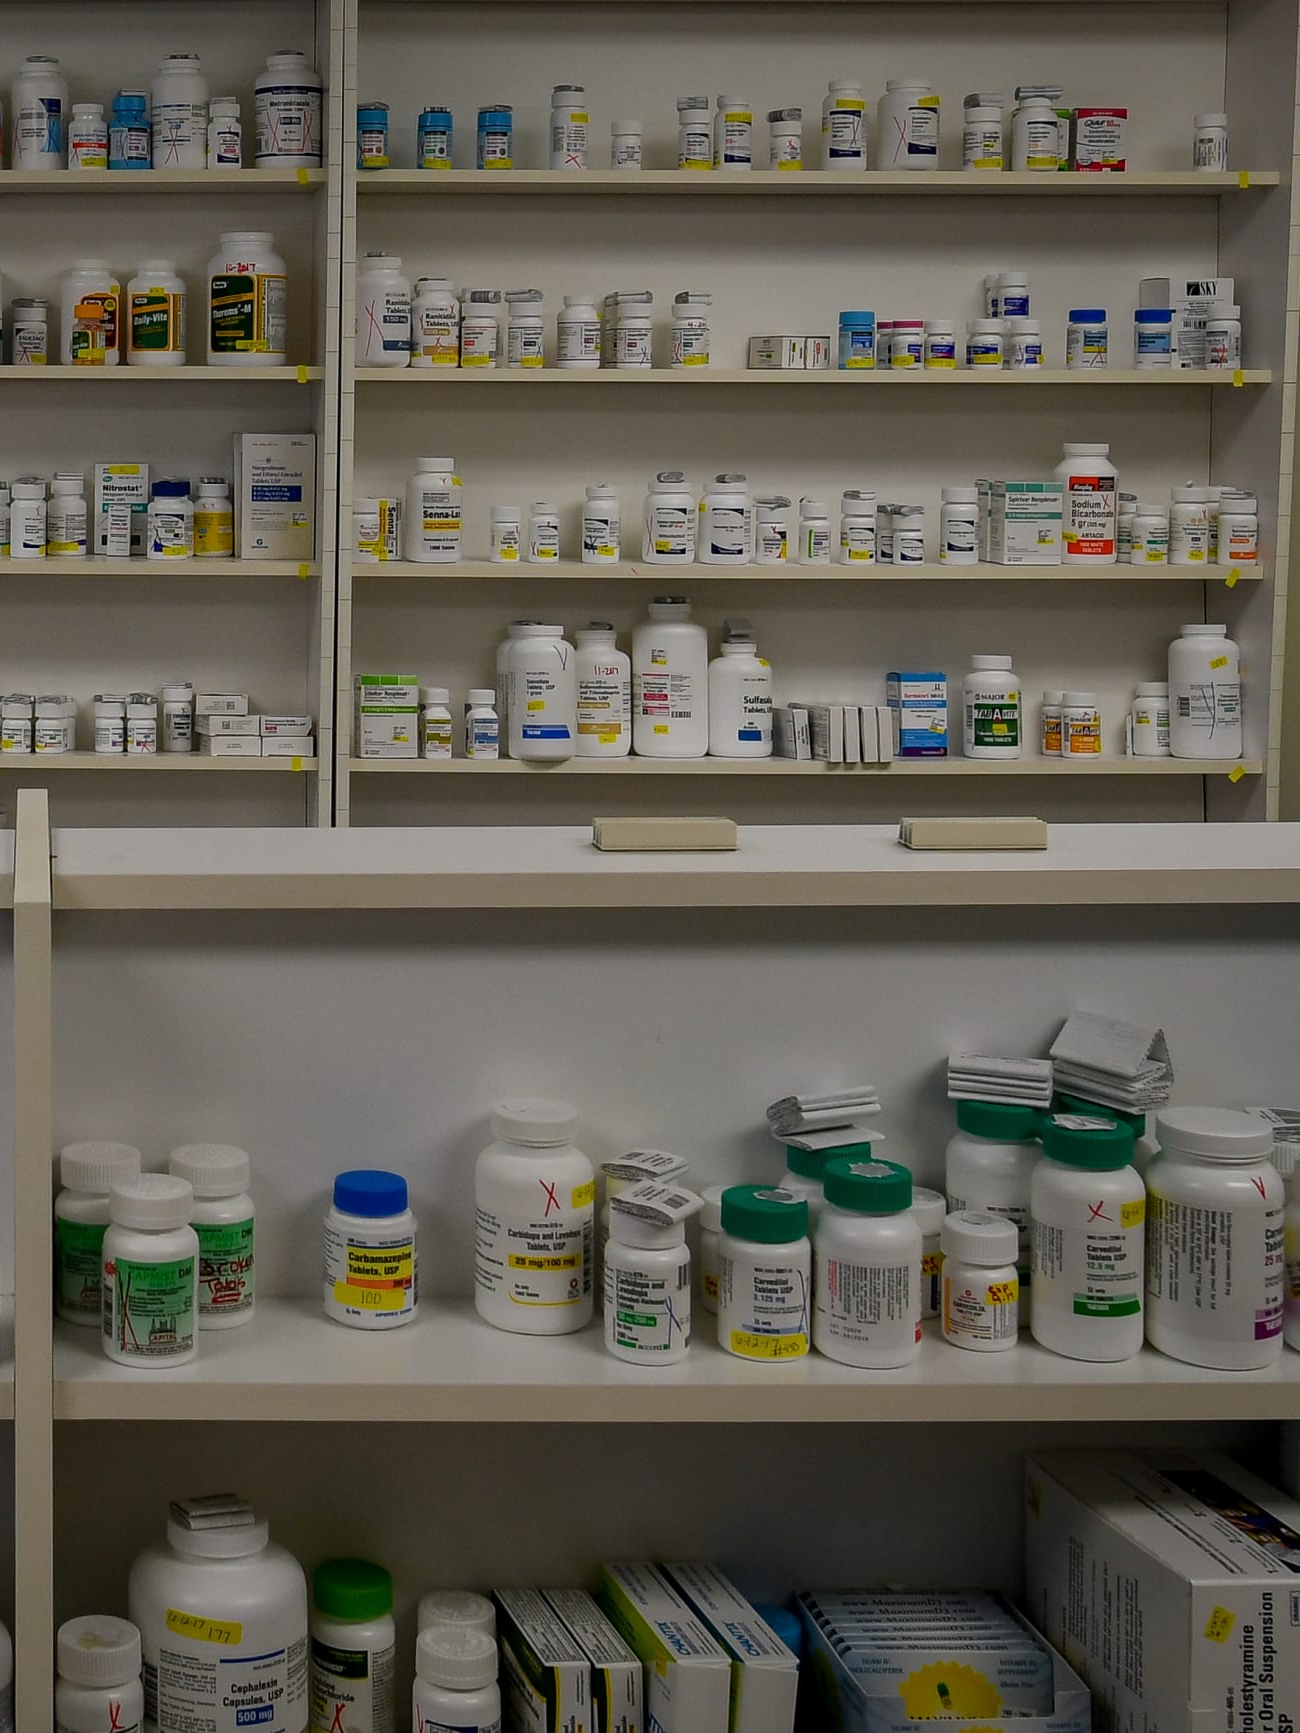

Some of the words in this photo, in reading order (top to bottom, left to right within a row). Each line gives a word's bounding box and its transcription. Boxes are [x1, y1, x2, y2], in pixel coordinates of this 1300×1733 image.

[1200, 281, 1218, 296] SKY
[134, 313, 167, 325] Daily-Vite
[1072, 500, 1102, 508] Sodium
[1072, 510, 1115, 518] Bicarbonate
[1078, 520, 1086, 528] gr
[507, 1229, 540, 1240] Carbidopa
[541, 1230, 554, 1239] and
[526, 1242, 551, 1252] Tablets,
[553, 1242, 566, 1251] USP
[1087, 1244, 1122, 1254] Carvedilol
[348, 1251, 412, 1265] Carbamazepine
[515, 1258, 526, 1266] 25
[529, 1258, 562, 1268] mg/100
[563, 1258, 576, 1267] mg
[1087, 1252, 1112, 1262] Tablets
[1113, 1252, 1127, 1262] USP
[348, 1263, 381, 1277] Tablets,
[384, 1265, 400, 1276] USP
[1103, 1263, 1116, 1272] mg
[754, 1276, 789, 1286] Carvedilol
[754, 1284, 778, 1294] Tablets
[779, 1286, 793, 1295] USP
[360, 1291, 383, 1305] 100
[1259, 1592, 1277, 1683] Suspension
[1239, 1625, 1256, 1733] holestyramine
[231, 1677, 279, 1695] Cephalexin
[223, 1695, 267, 1709] Capsules,
[268, 1687, 285, 1702] USP
[1259, 1688, 1274, 1721] Oral
[238, 1711, 257, 1724] 500
[258, 1709, 274, 1723] mg
[1279, 1714, 1293, 1733] SP
